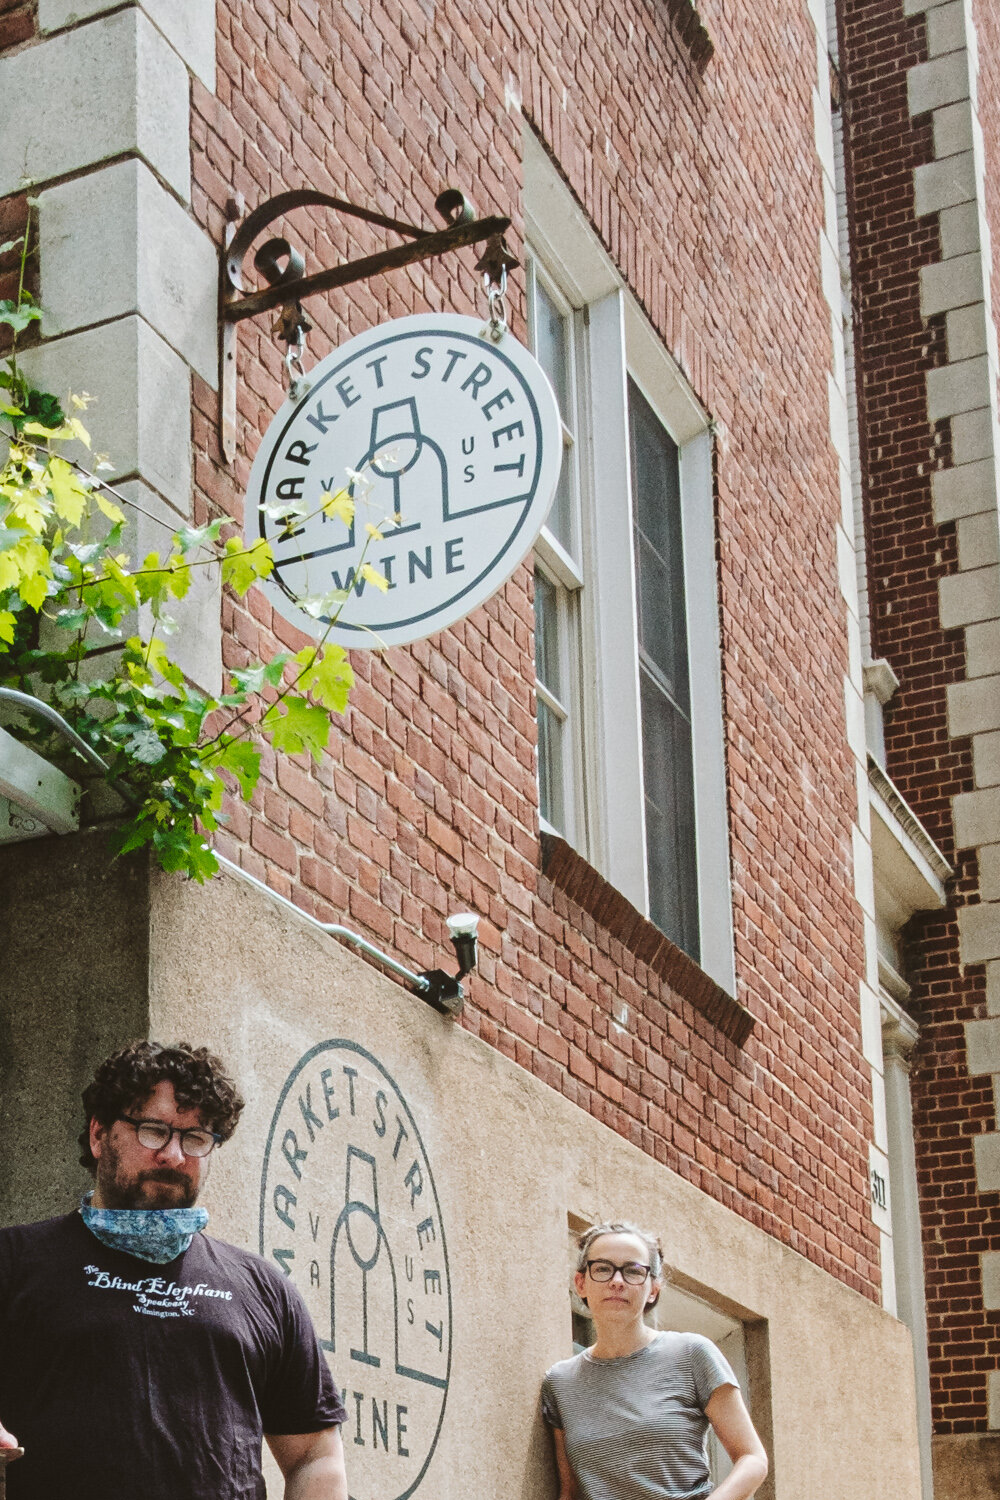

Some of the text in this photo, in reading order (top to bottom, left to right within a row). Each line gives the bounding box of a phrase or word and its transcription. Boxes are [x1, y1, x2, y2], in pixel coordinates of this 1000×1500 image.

[411, 347, 526, 478] STREET
[331, 537, 466, 598] WINE
[373, 1090, 445, 1353] STREET
[88, 1271, 233, 1301] Blind Elephant
[181, 1308, 196, 1317] NC
[340, 1388, 410, 1458] INE
